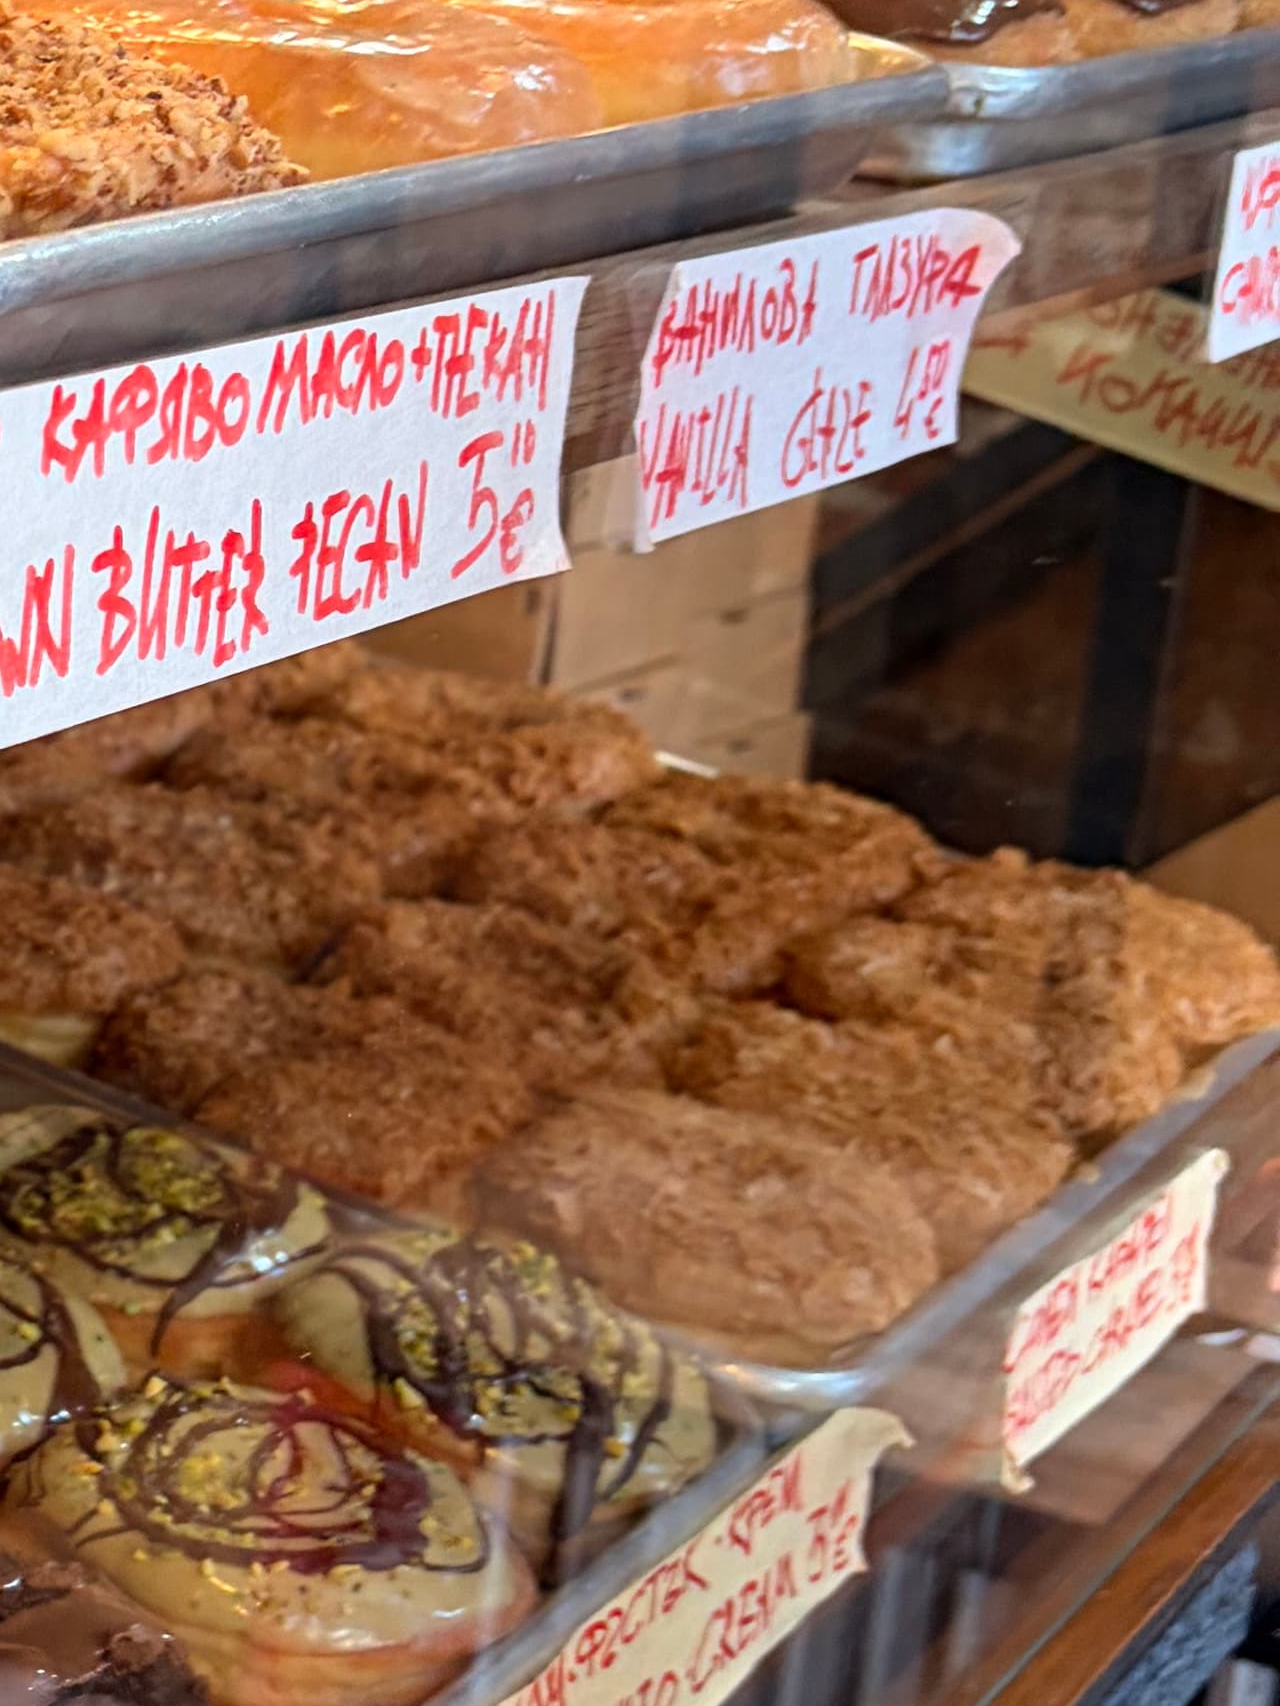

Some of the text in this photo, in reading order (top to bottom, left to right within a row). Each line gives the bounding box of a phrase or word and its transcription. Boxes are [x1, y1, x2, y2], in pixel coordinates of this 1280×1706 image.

[651, 233, 982, 390] ВАНИЛОВА ГЛАЗУРА
[41, 363, 251, 485] КАФЯВО
[91, 499, 270, 675] BUTTER
[289, 459, 429, 623] PECAN
